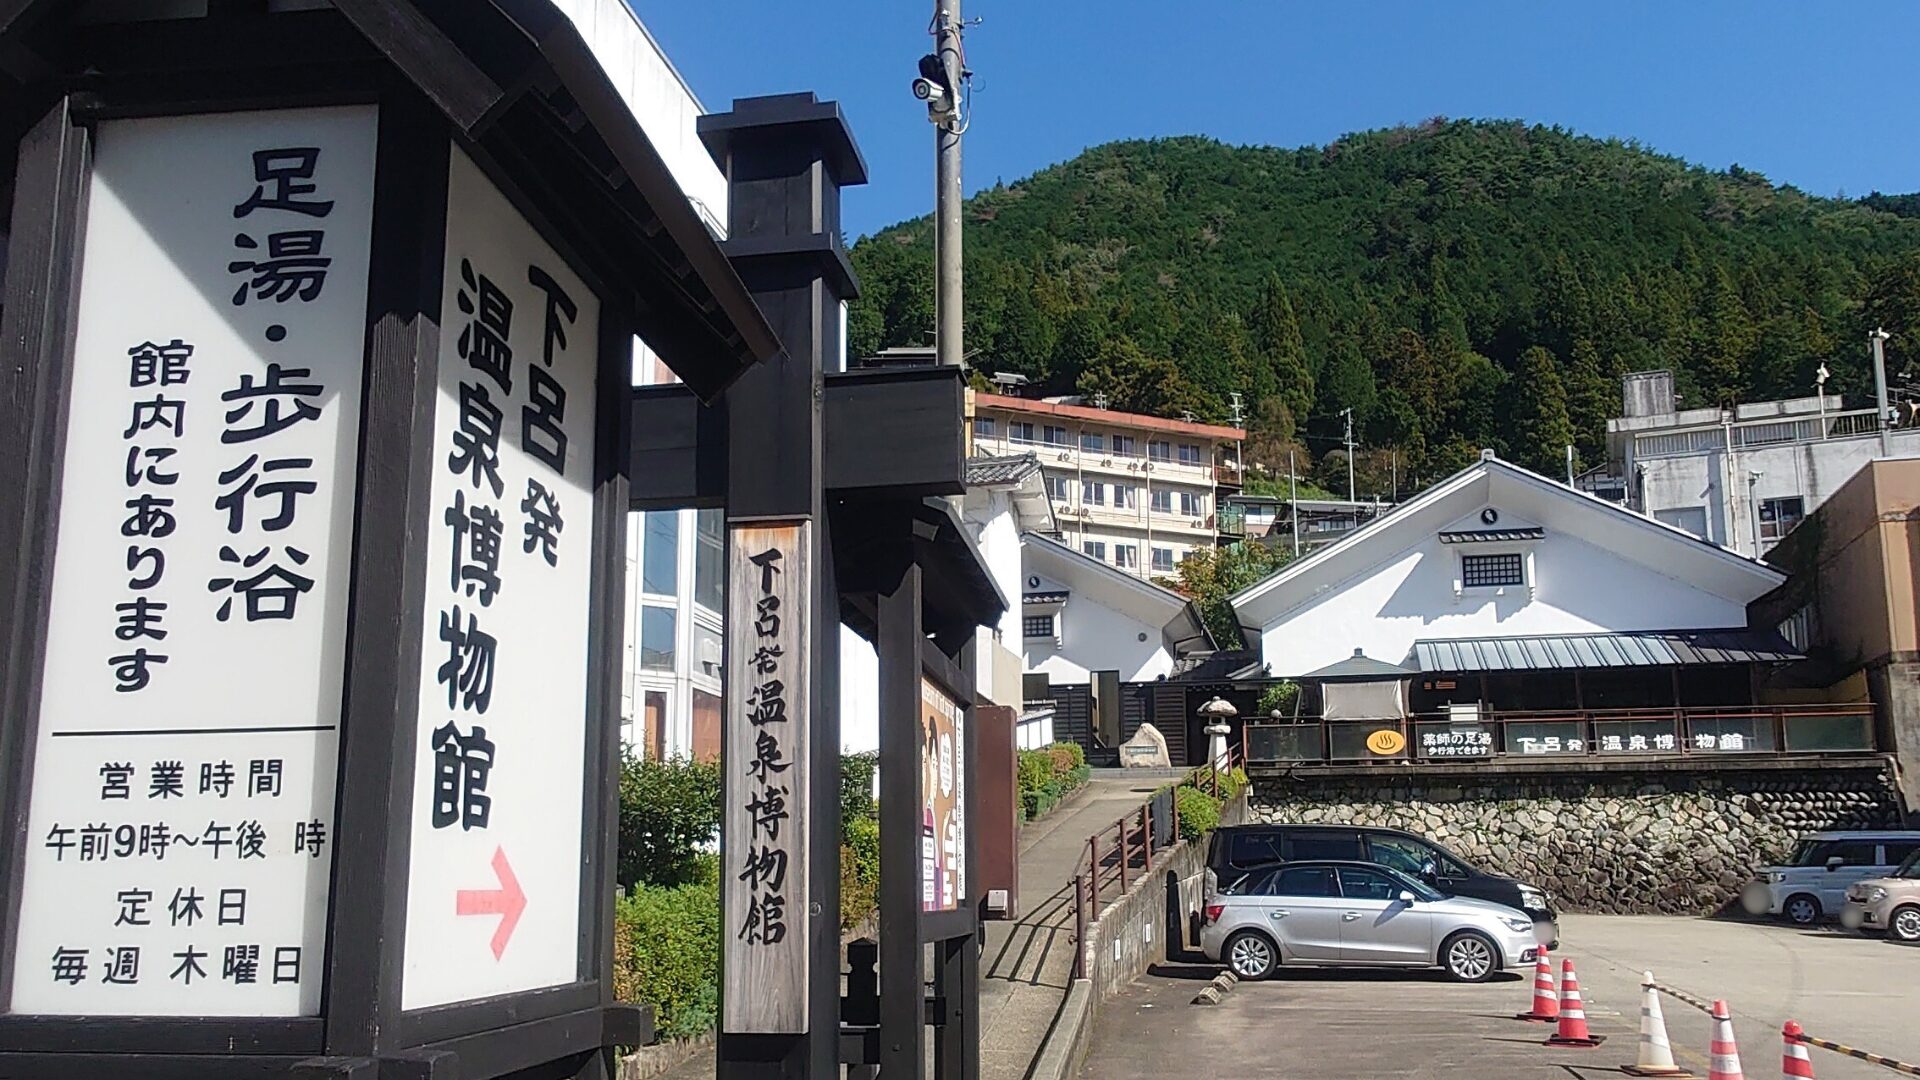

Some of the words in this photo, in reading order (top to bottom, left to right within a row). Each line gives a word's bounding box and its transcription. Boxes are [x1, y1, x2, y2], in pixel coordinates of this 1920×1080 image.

[108, 339, 194, 692] 館内にあります
[208, 147, 335, 622] 足湯・歩行浴
[431, 258, 514, 832] 温泉博物館
[520, 264, 578, 567] 下呂発
[99, 759, 283, 800] 営業時間
[114, 886, 246, 927] 定休日
[738, 547, 795, 946] 下呂発温泉博物館
